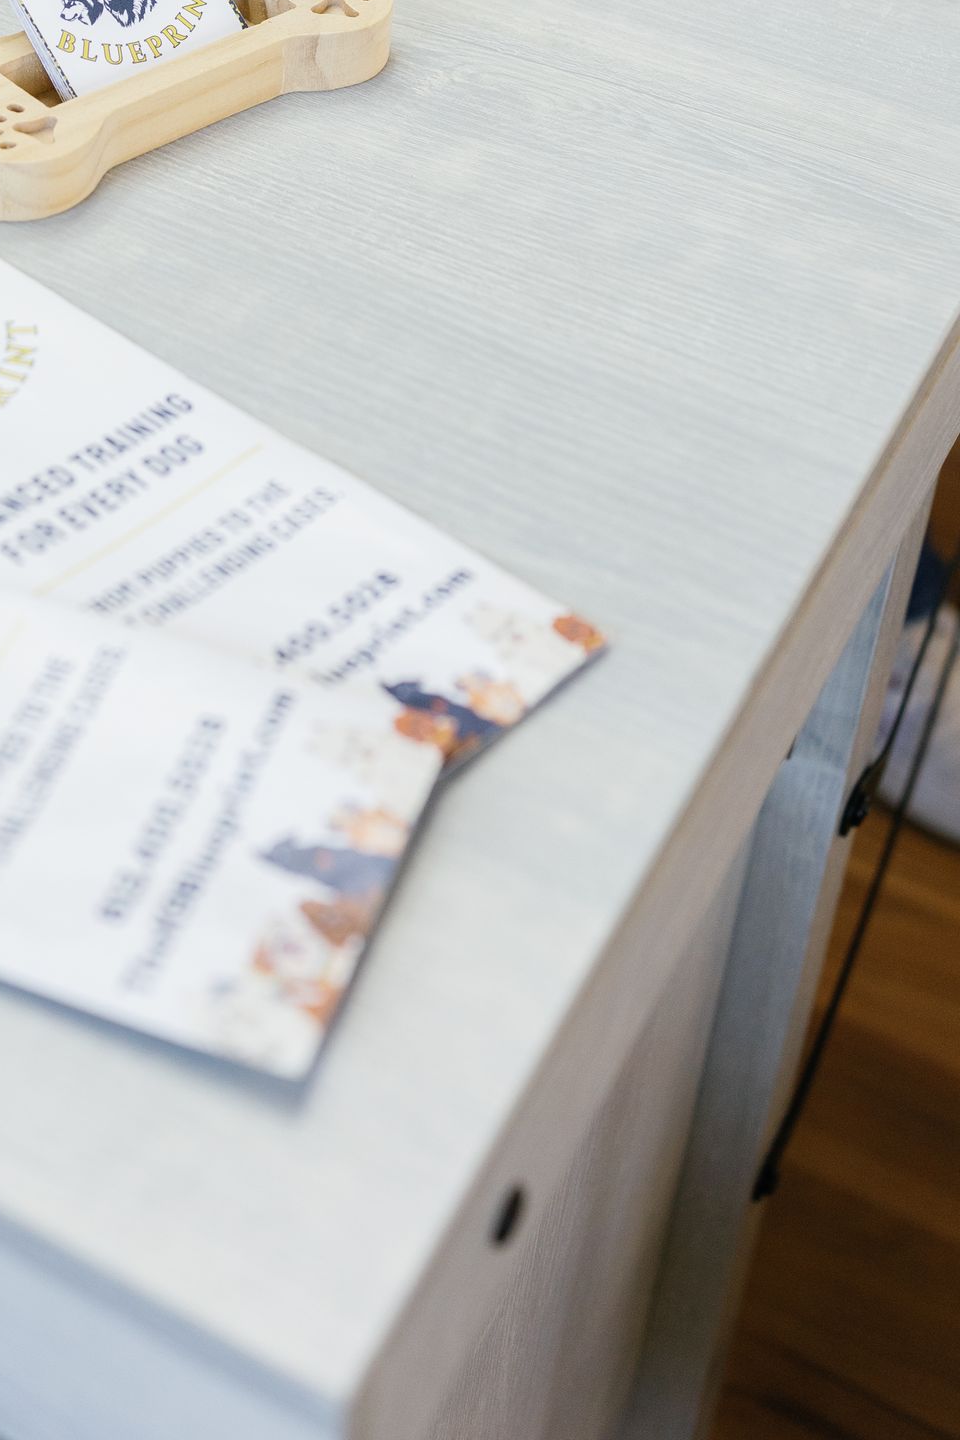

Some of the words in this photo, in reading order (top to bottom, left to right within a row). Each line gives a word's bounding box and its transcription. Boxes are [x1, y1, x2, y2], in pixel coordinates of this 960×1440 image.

[69, 393, 193, 473] TRAINING
[0, 520, 65, 566] FOR
[58, 468, 149, 531] EVERY
[141, 435, 204, 476] DOG
